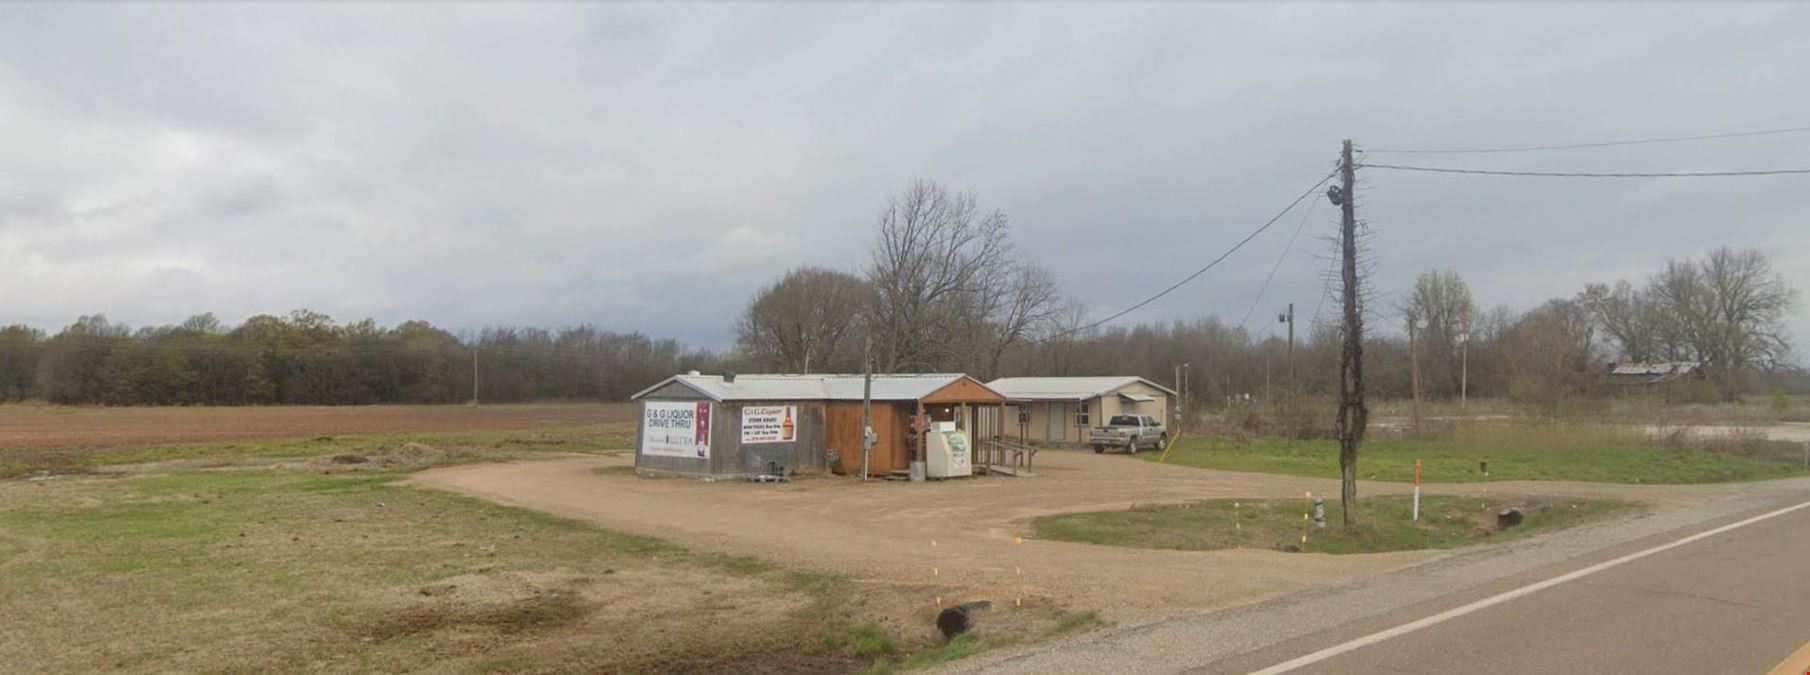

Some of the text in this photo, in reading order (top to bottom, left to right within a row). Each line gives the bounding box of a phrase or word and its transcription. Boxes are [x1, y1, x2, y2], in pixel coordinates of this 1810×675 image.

[647, 409, 694, 419] G & G LIQUOR
[649, 419, 691, 429] DRIVE THRU
